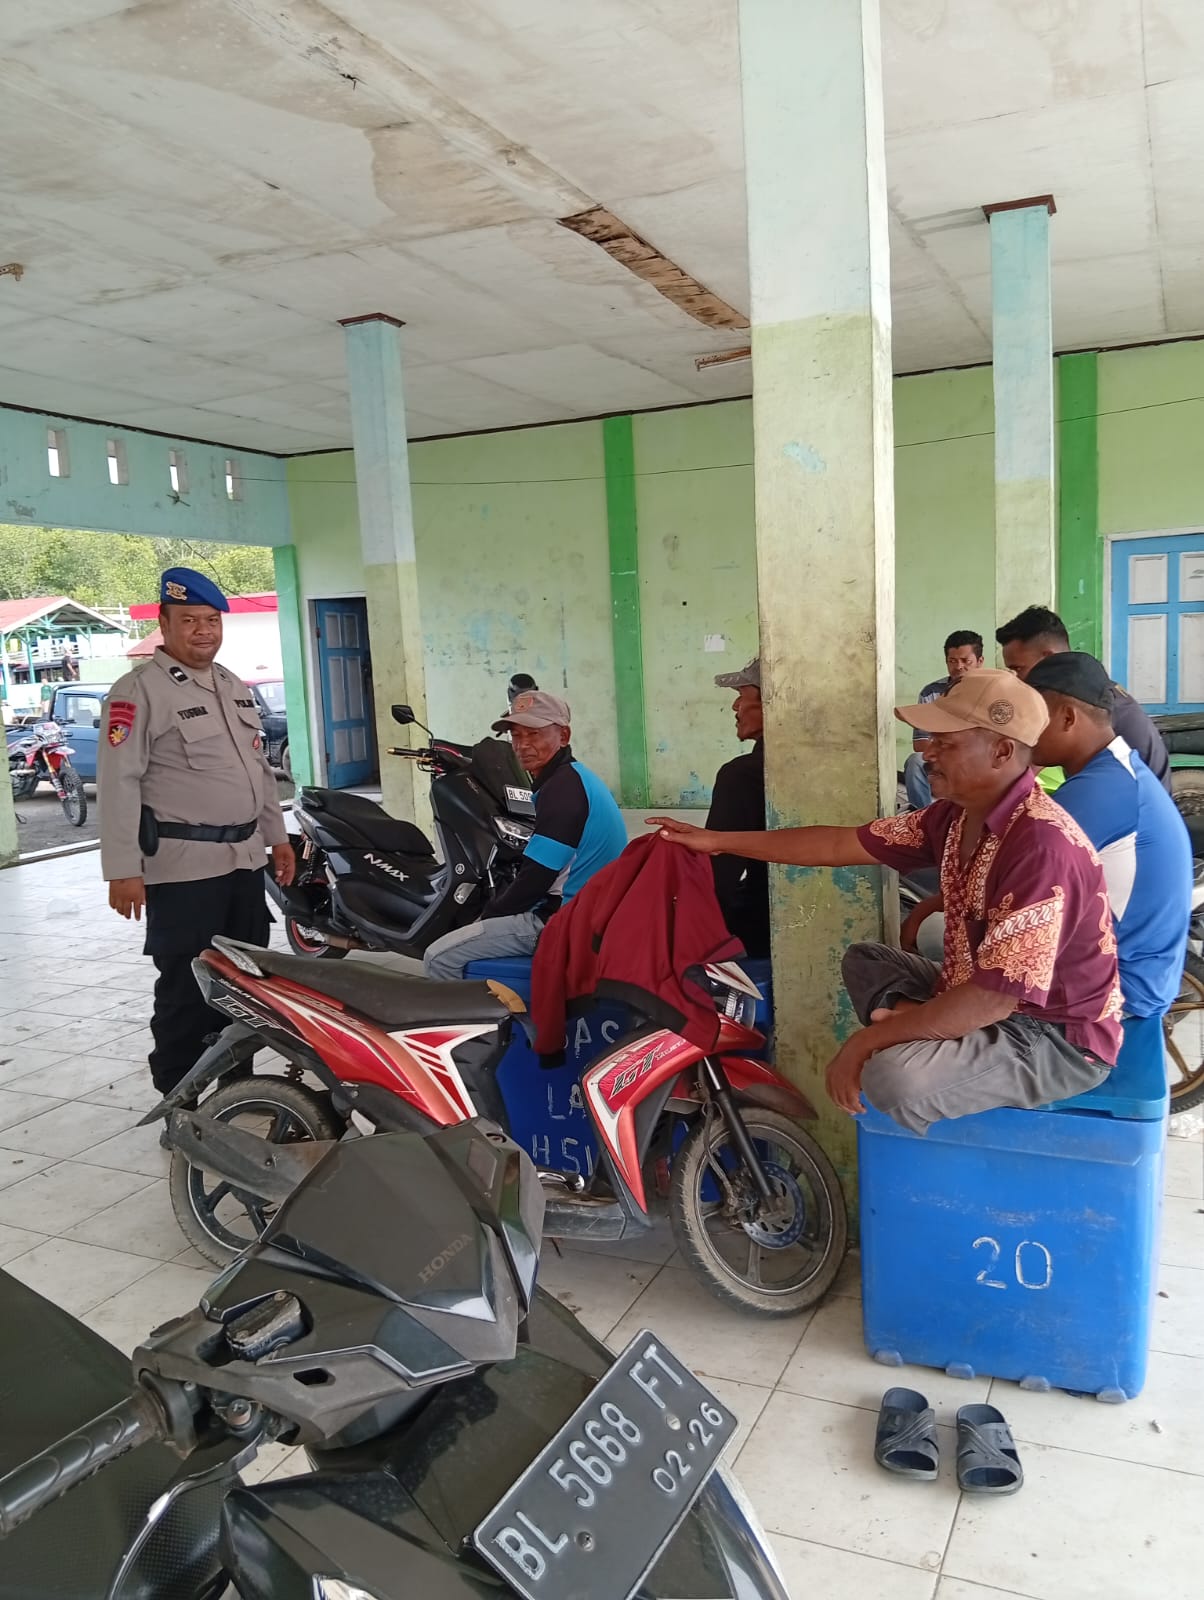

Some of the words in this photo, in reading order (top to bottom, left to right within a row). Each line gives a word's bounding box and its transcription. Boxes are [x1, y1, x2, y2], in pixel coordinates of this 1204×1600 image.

[508, 790, 518, 799] BL
[363, 853, 410, 882] NMAX
[417, 1233, 473, 1284] HONDA
[972, 1236, 1054, 1290] 20
[493, 1511, 569, 1580] BL
[549, 1402, 641, 1507] 5668
[628, 1343, 683, 1409] FT
